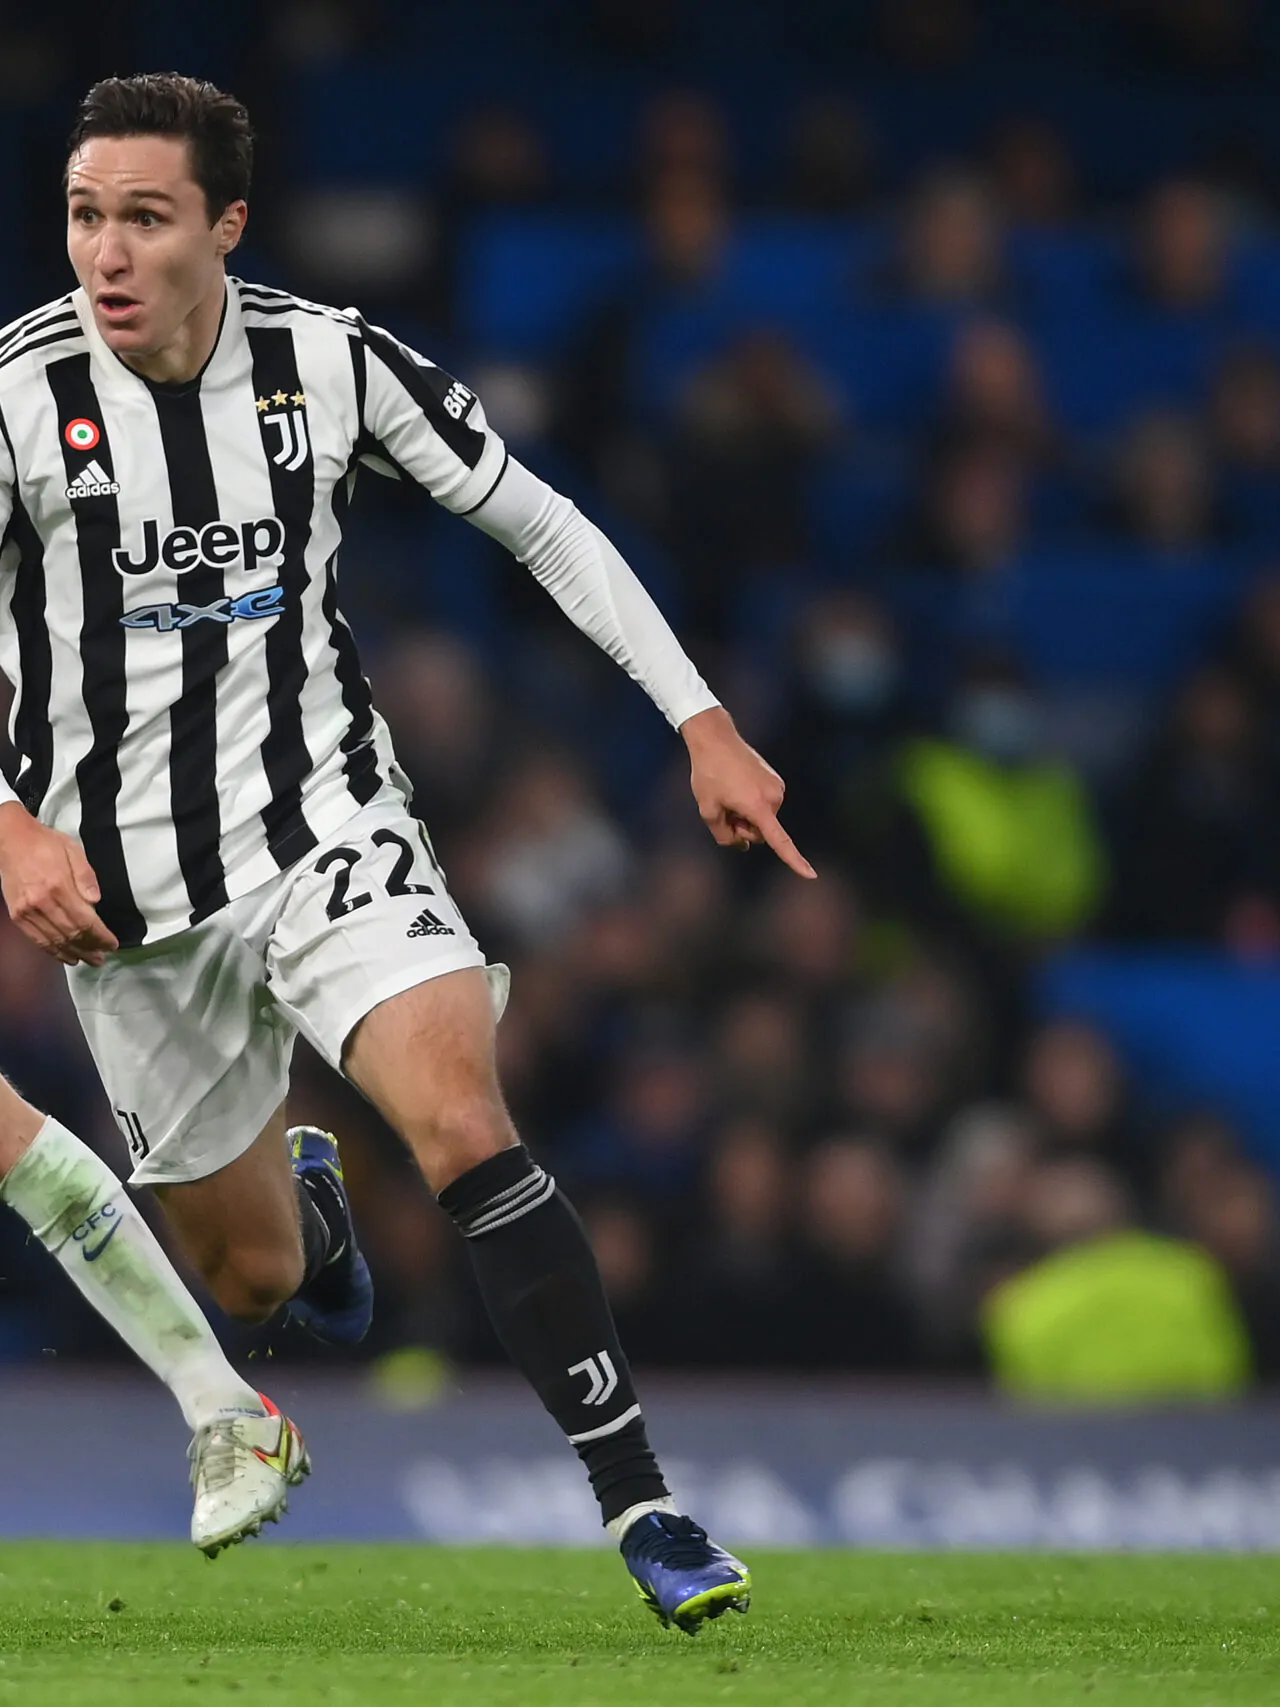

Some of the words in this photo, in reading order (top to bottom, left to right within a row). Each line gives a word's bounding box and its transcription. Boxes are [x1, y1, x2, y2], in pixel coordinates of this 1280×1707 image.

[65, 482, 120, 499] adidas
[114, 517, 284, 575] Jeep
[314, 829, 436, 923] 22
[406, 924, 456, 938] adidas
[73, 1203, 116, 1241] CFC
